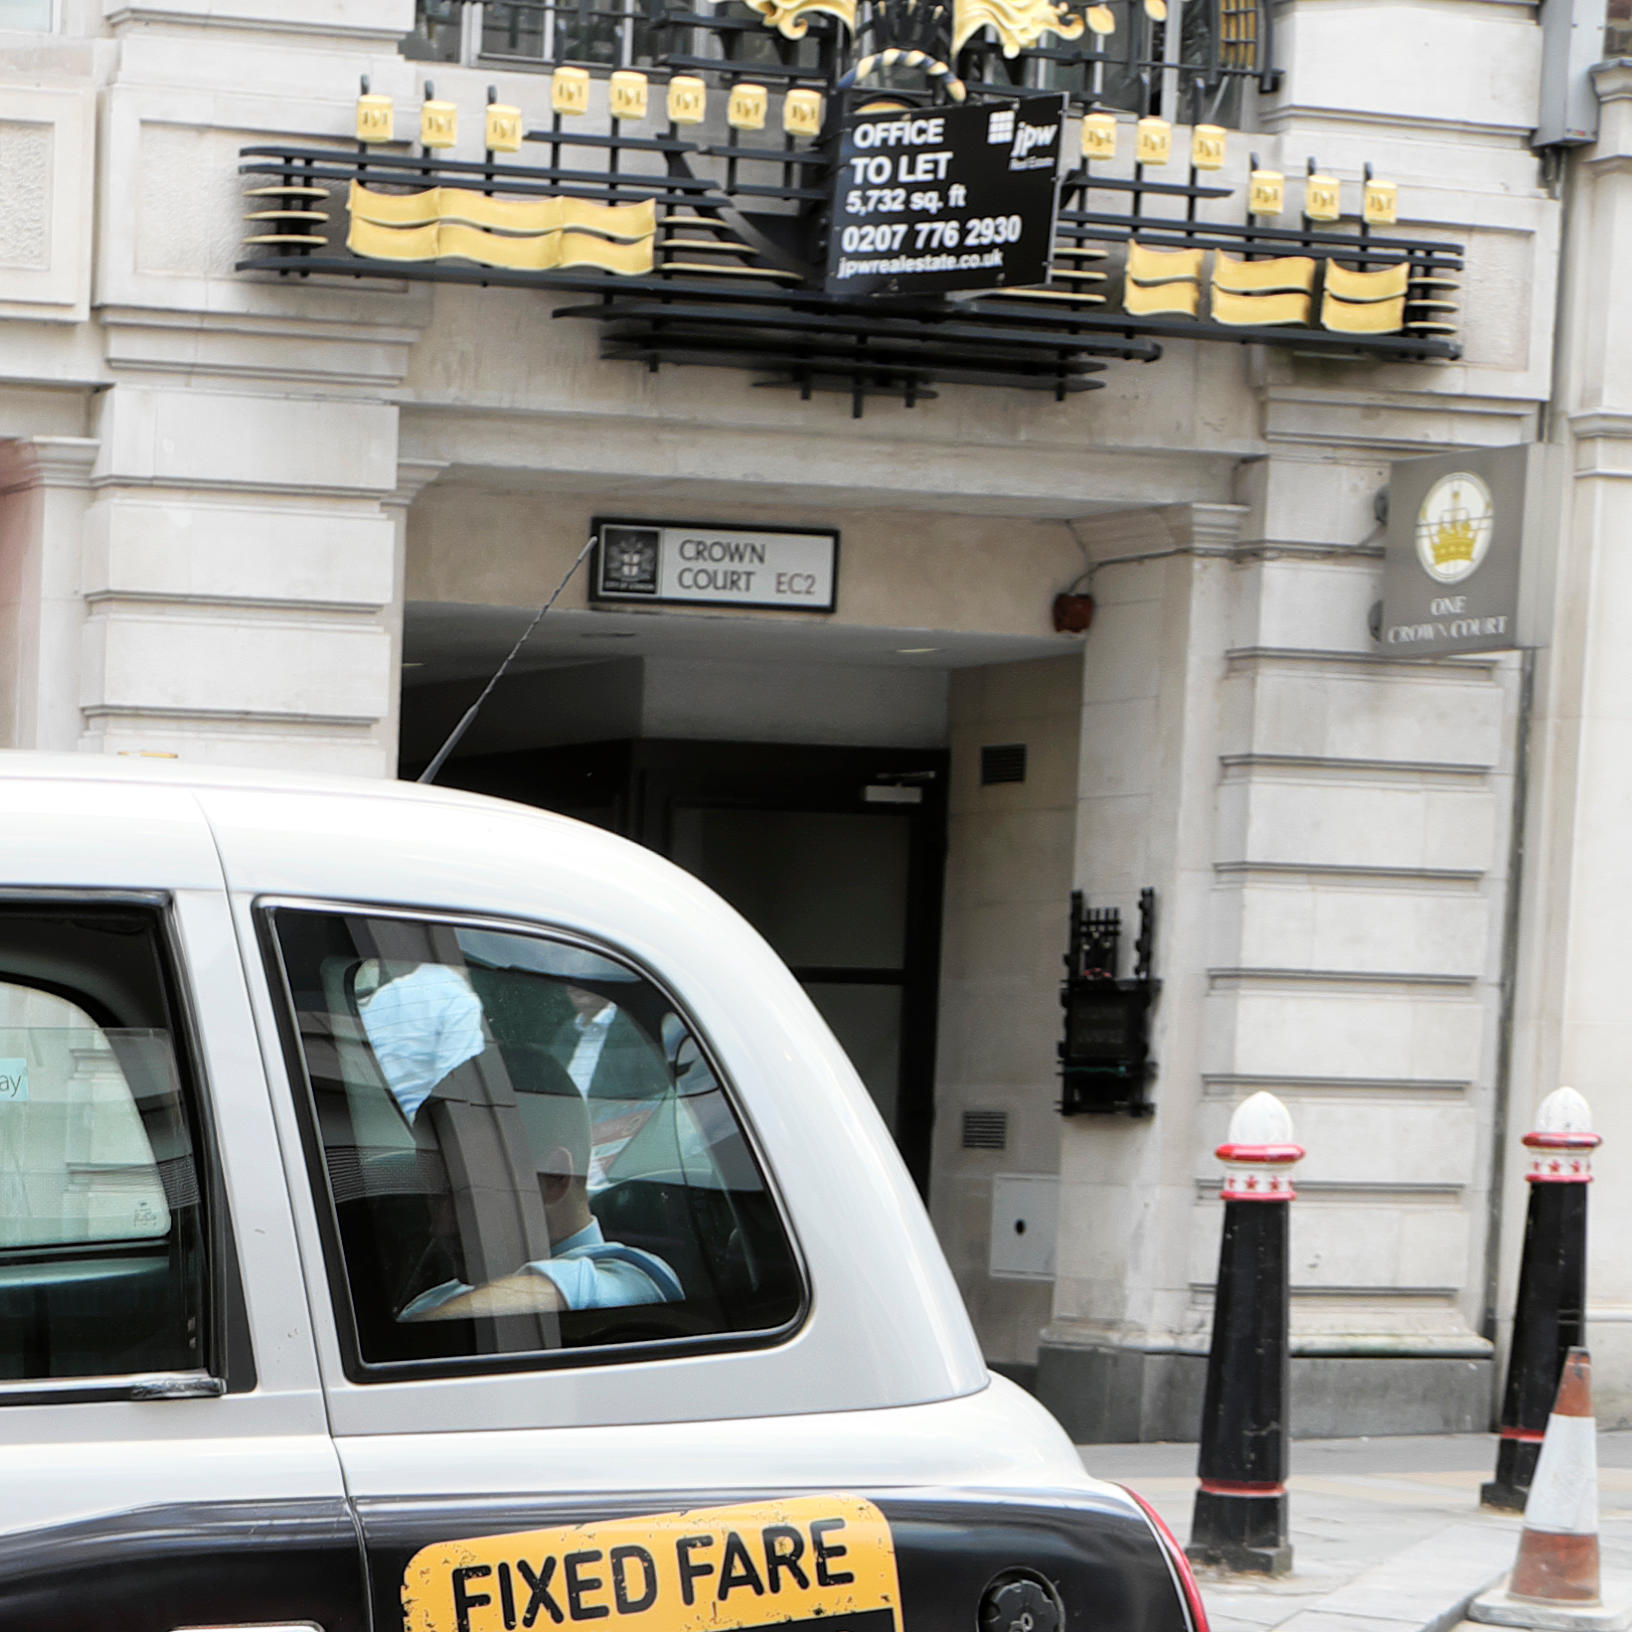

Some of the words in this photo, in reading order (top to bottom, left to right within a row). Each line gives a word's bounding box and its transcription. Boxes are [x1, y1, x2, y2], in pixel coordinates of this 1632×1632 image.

[853, 117, 945, 148] OFFICE
[1009, 121, 1058, 157] jpw
[849, 156, 892, 185] TO
[898, 151, 954, 183] LET
[845, 188, 906, 216] 5,732
[909, 190, 944, 215] sq.
[947, 183, 967, 208] ft
[841, 224, 908, 254] 0207
[914, 220, 960, 250] 776
[964, 214, 1022, 246] 2930
[837, 248, 1004, 278] jpwrealestate.co.uk
[678, 538, 766, 565] CROWN
[677, 567, 756, 592] COURT
[775, 572, 816, 596] EC2
[1430, 595, 1468, 616] ONE
[1388, 622, 1447, 644] CROWN
[1450, 615, 1508, 639] COURT
[674, 1518, 855, 1607] FARE
